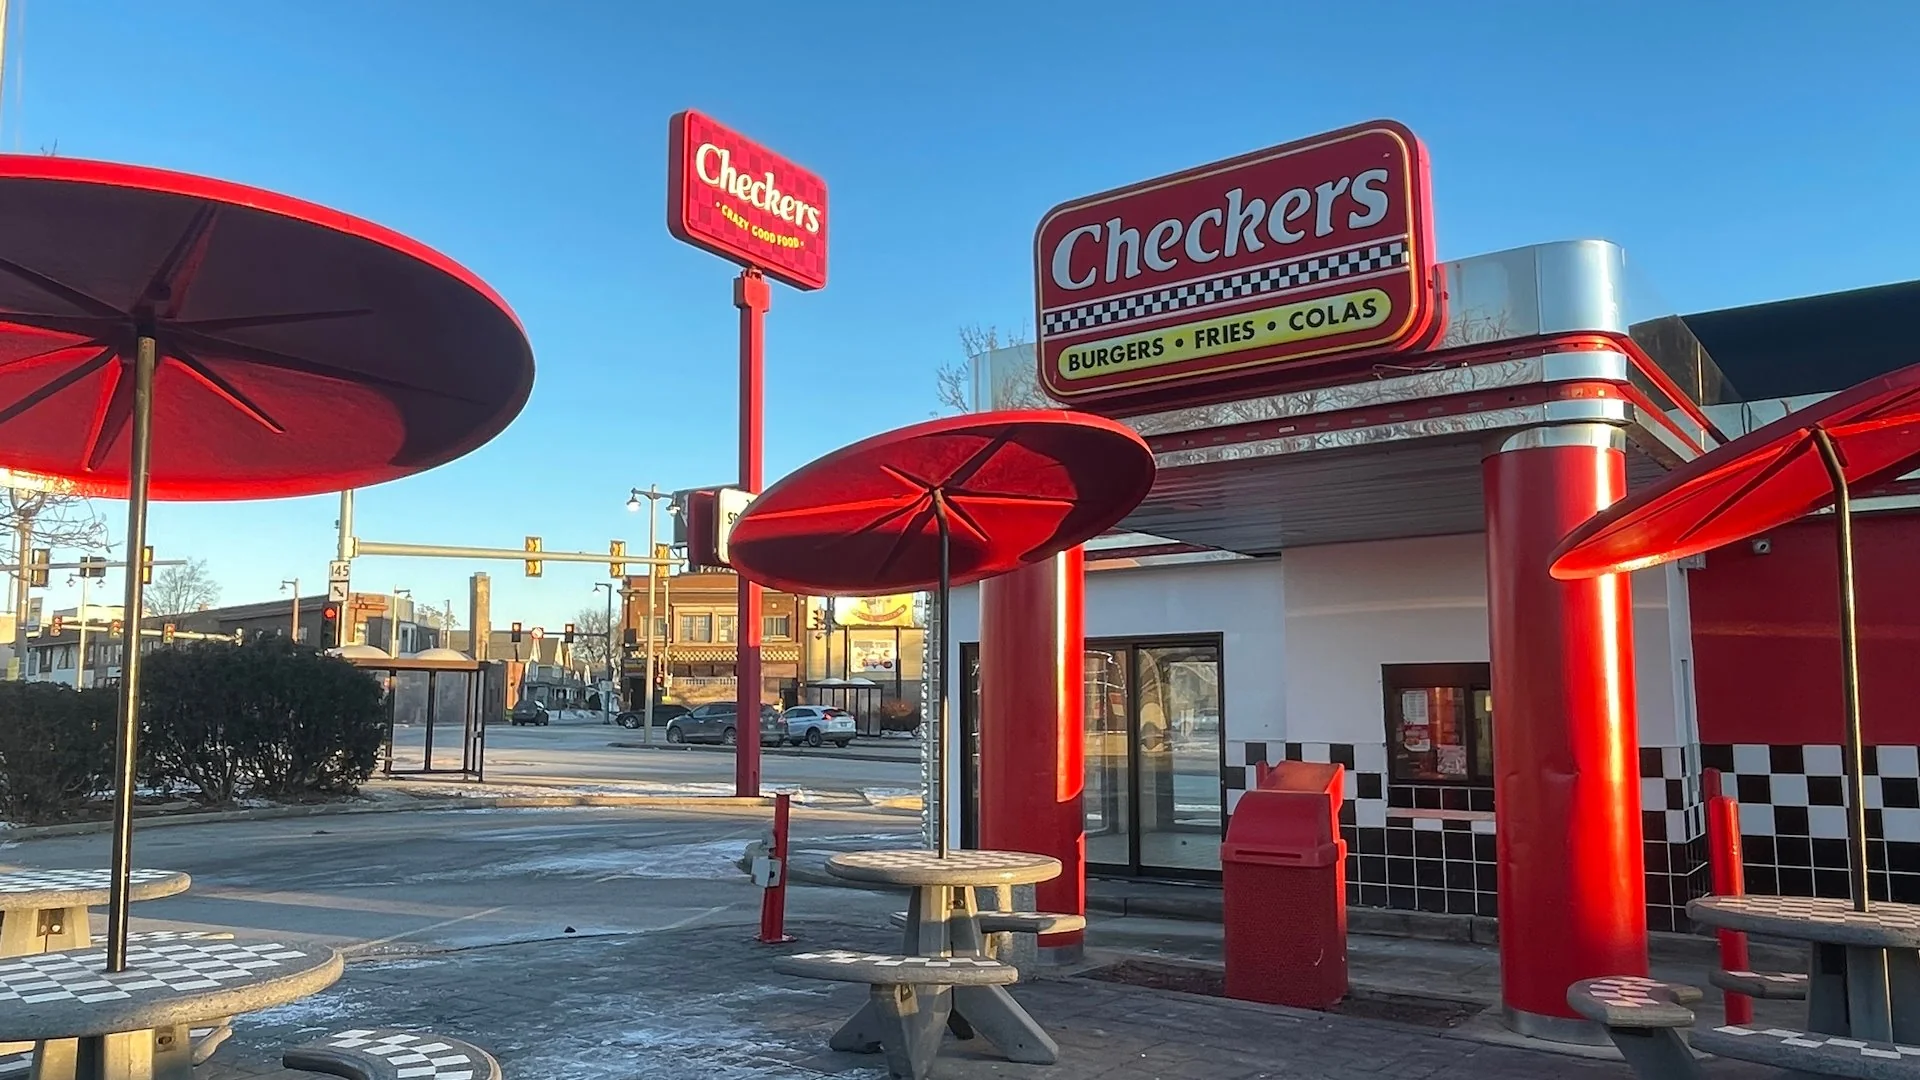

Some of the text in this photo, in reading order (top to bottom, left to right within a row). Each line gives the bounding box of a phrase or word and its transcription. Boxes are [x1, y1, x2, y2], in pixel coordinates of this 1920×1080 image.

[695, 143, 821, 234] Checkers
[721, 204, 750, 231] CRAZY
[777, 235, 800, 249] FOOD
[1051, 168, 1389, 291] Checkers
[1068, 298, 1378, 372] BURGERS FRIES COLAS
[331, 564, 349, 577] 145
